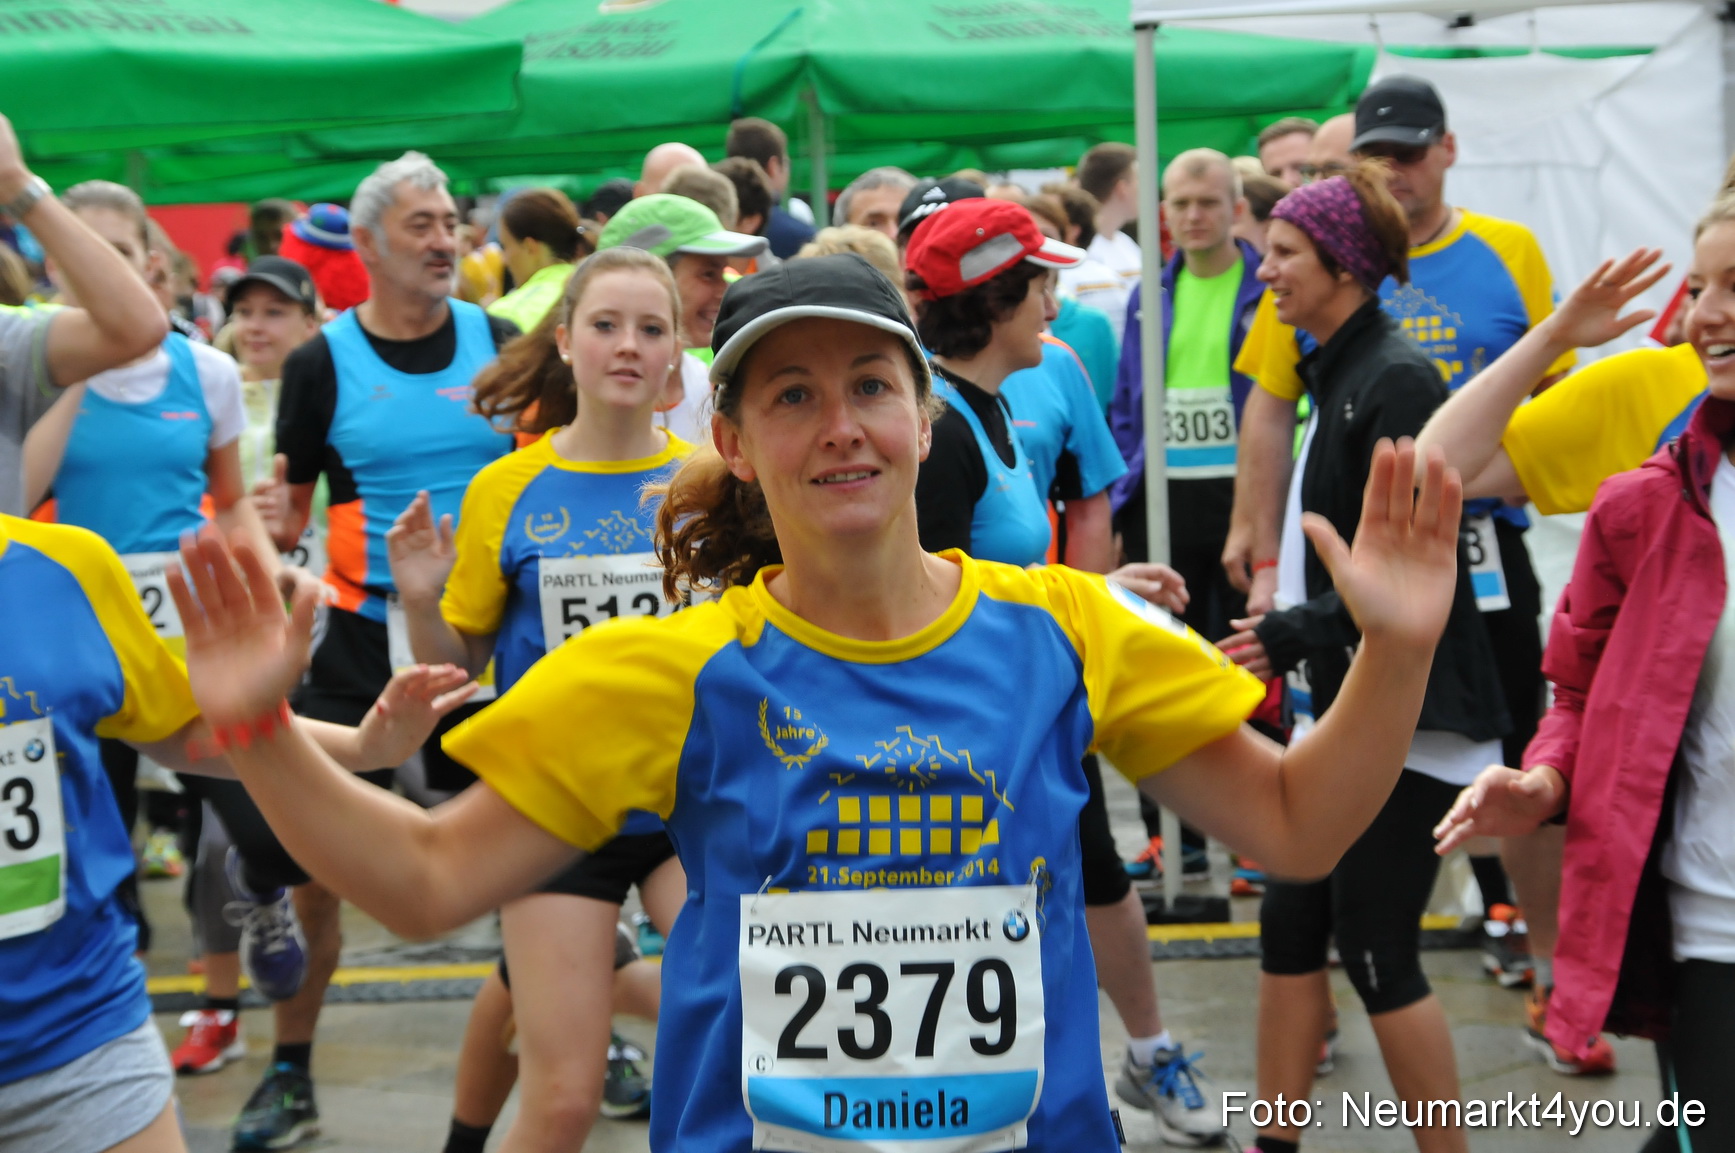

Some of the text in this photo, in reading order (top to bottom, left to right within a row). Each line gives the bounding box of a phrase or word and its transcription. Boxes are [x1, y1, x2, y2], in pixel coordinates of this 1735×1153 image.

[543, 573, 598, 588] PARTL
[775, 724, 816, 740] Jahre
[747, 917, 992, 947] PARTL Neumarkt
[773, 957, 1018, 1061] 2379
[823, 1090, 970, 1130] Daniela
